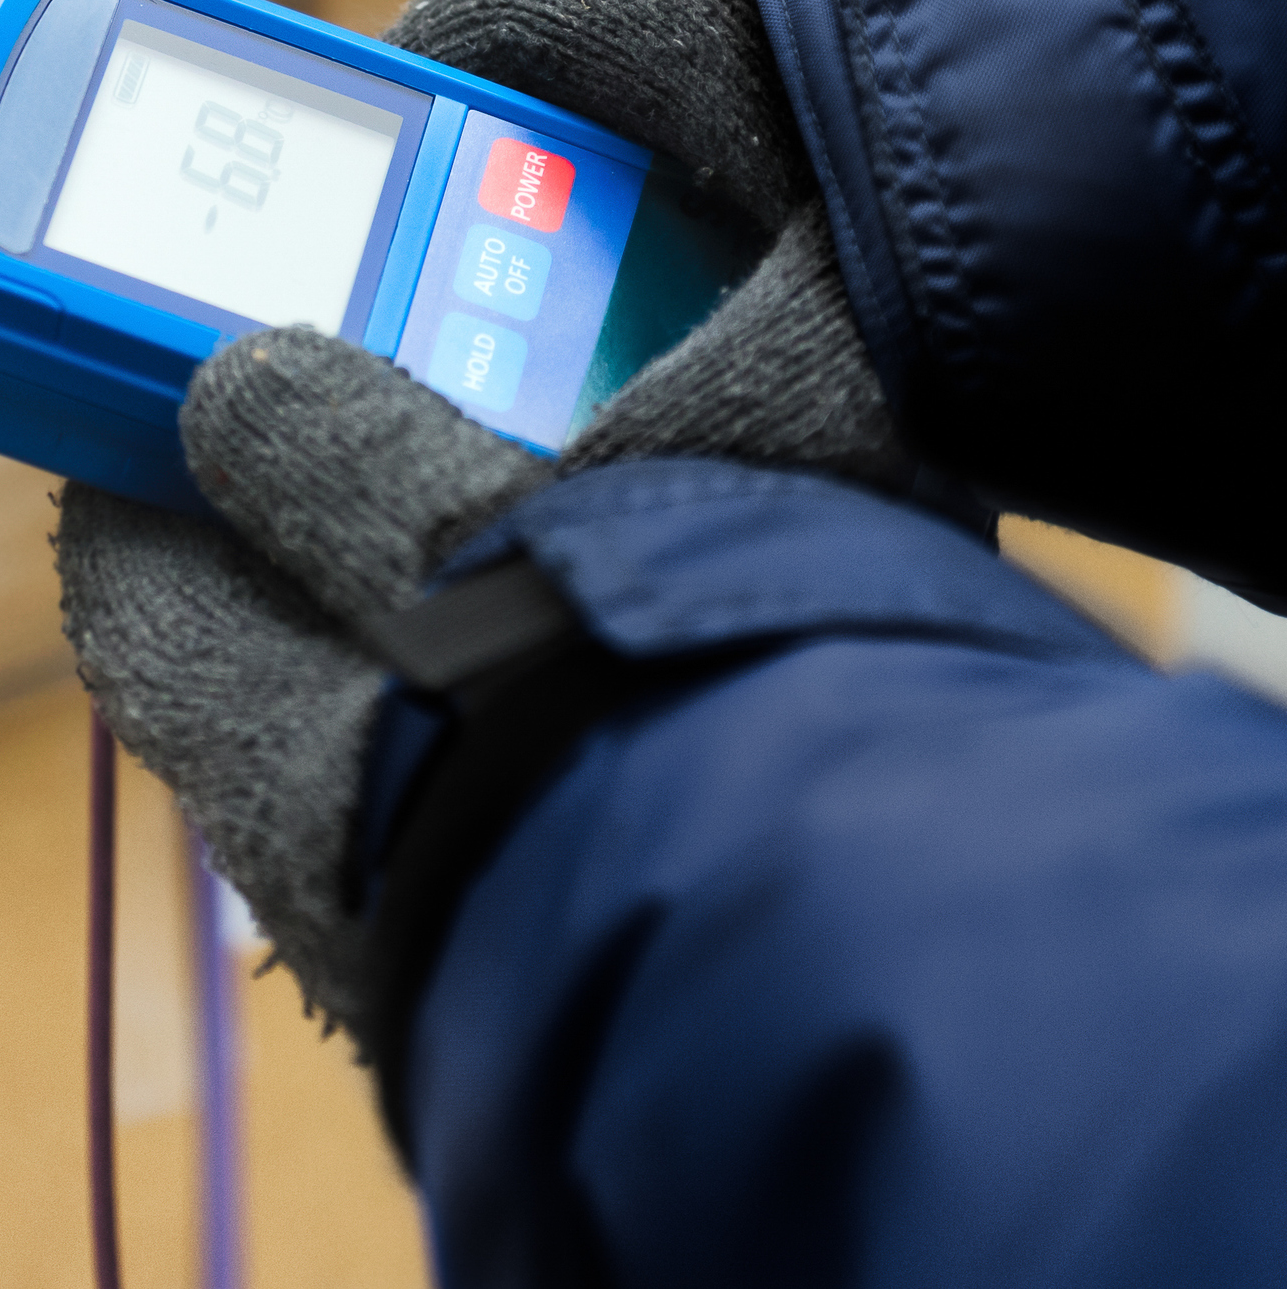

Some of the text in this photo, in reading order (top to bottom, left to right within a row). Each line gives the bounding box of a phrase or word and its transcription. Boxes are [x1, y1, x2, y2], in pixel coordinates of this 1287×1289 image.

[510, 150, 548, 222] POWER
[473, 237, 506, 297] AUTO
[504, 255, 531, 295] OFF
[462, 332, 496, 393] HOLD
